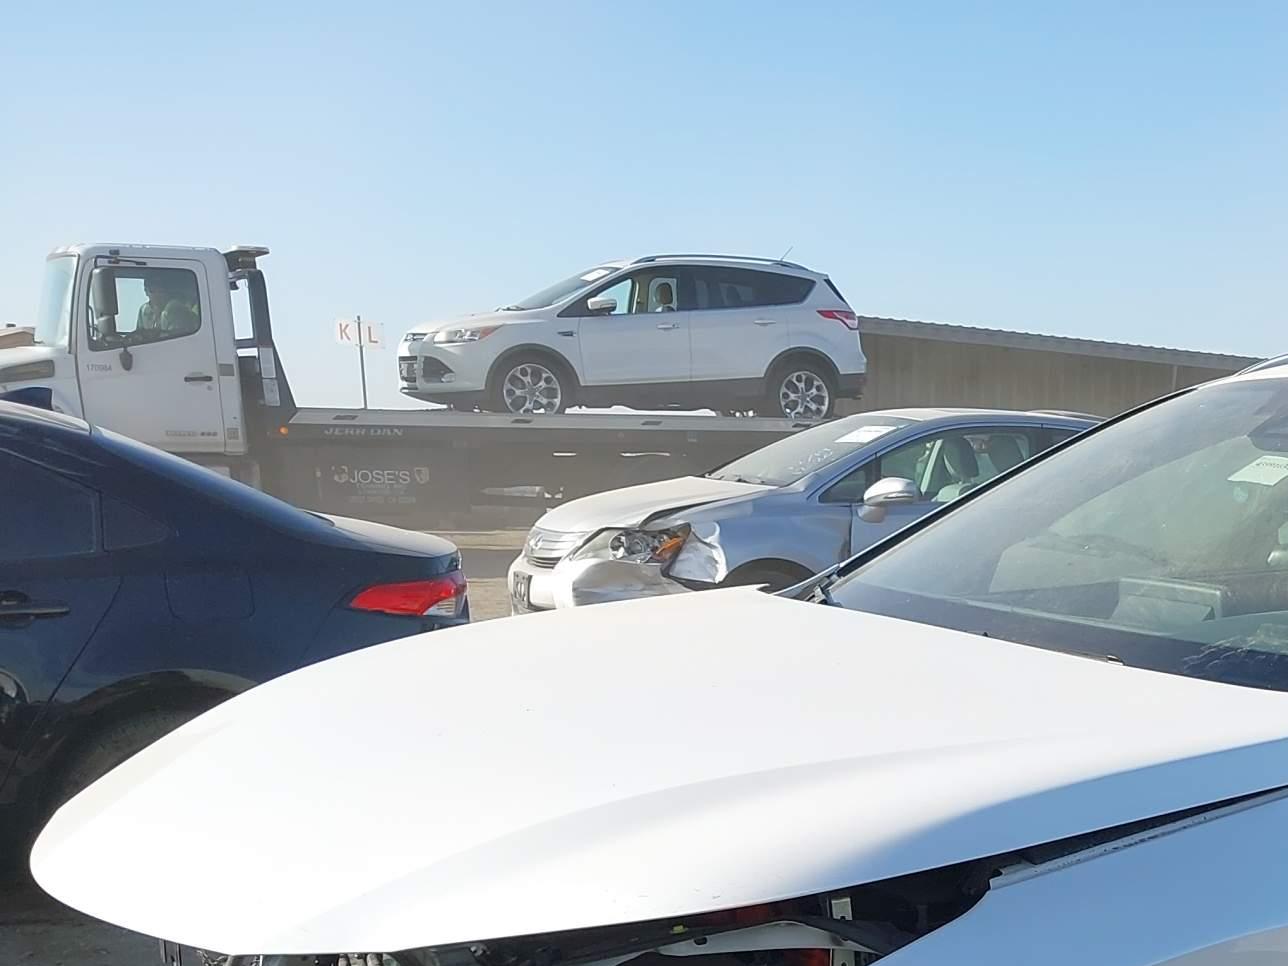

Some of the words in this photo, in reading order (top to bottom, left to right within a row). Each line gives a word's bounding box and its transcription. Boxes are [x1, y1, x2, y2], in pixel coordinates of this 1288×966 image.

[338, 322, 351, 341] K
[367, 326, 379, 343] L
[350, 469, 411, 484] JOSE'S
